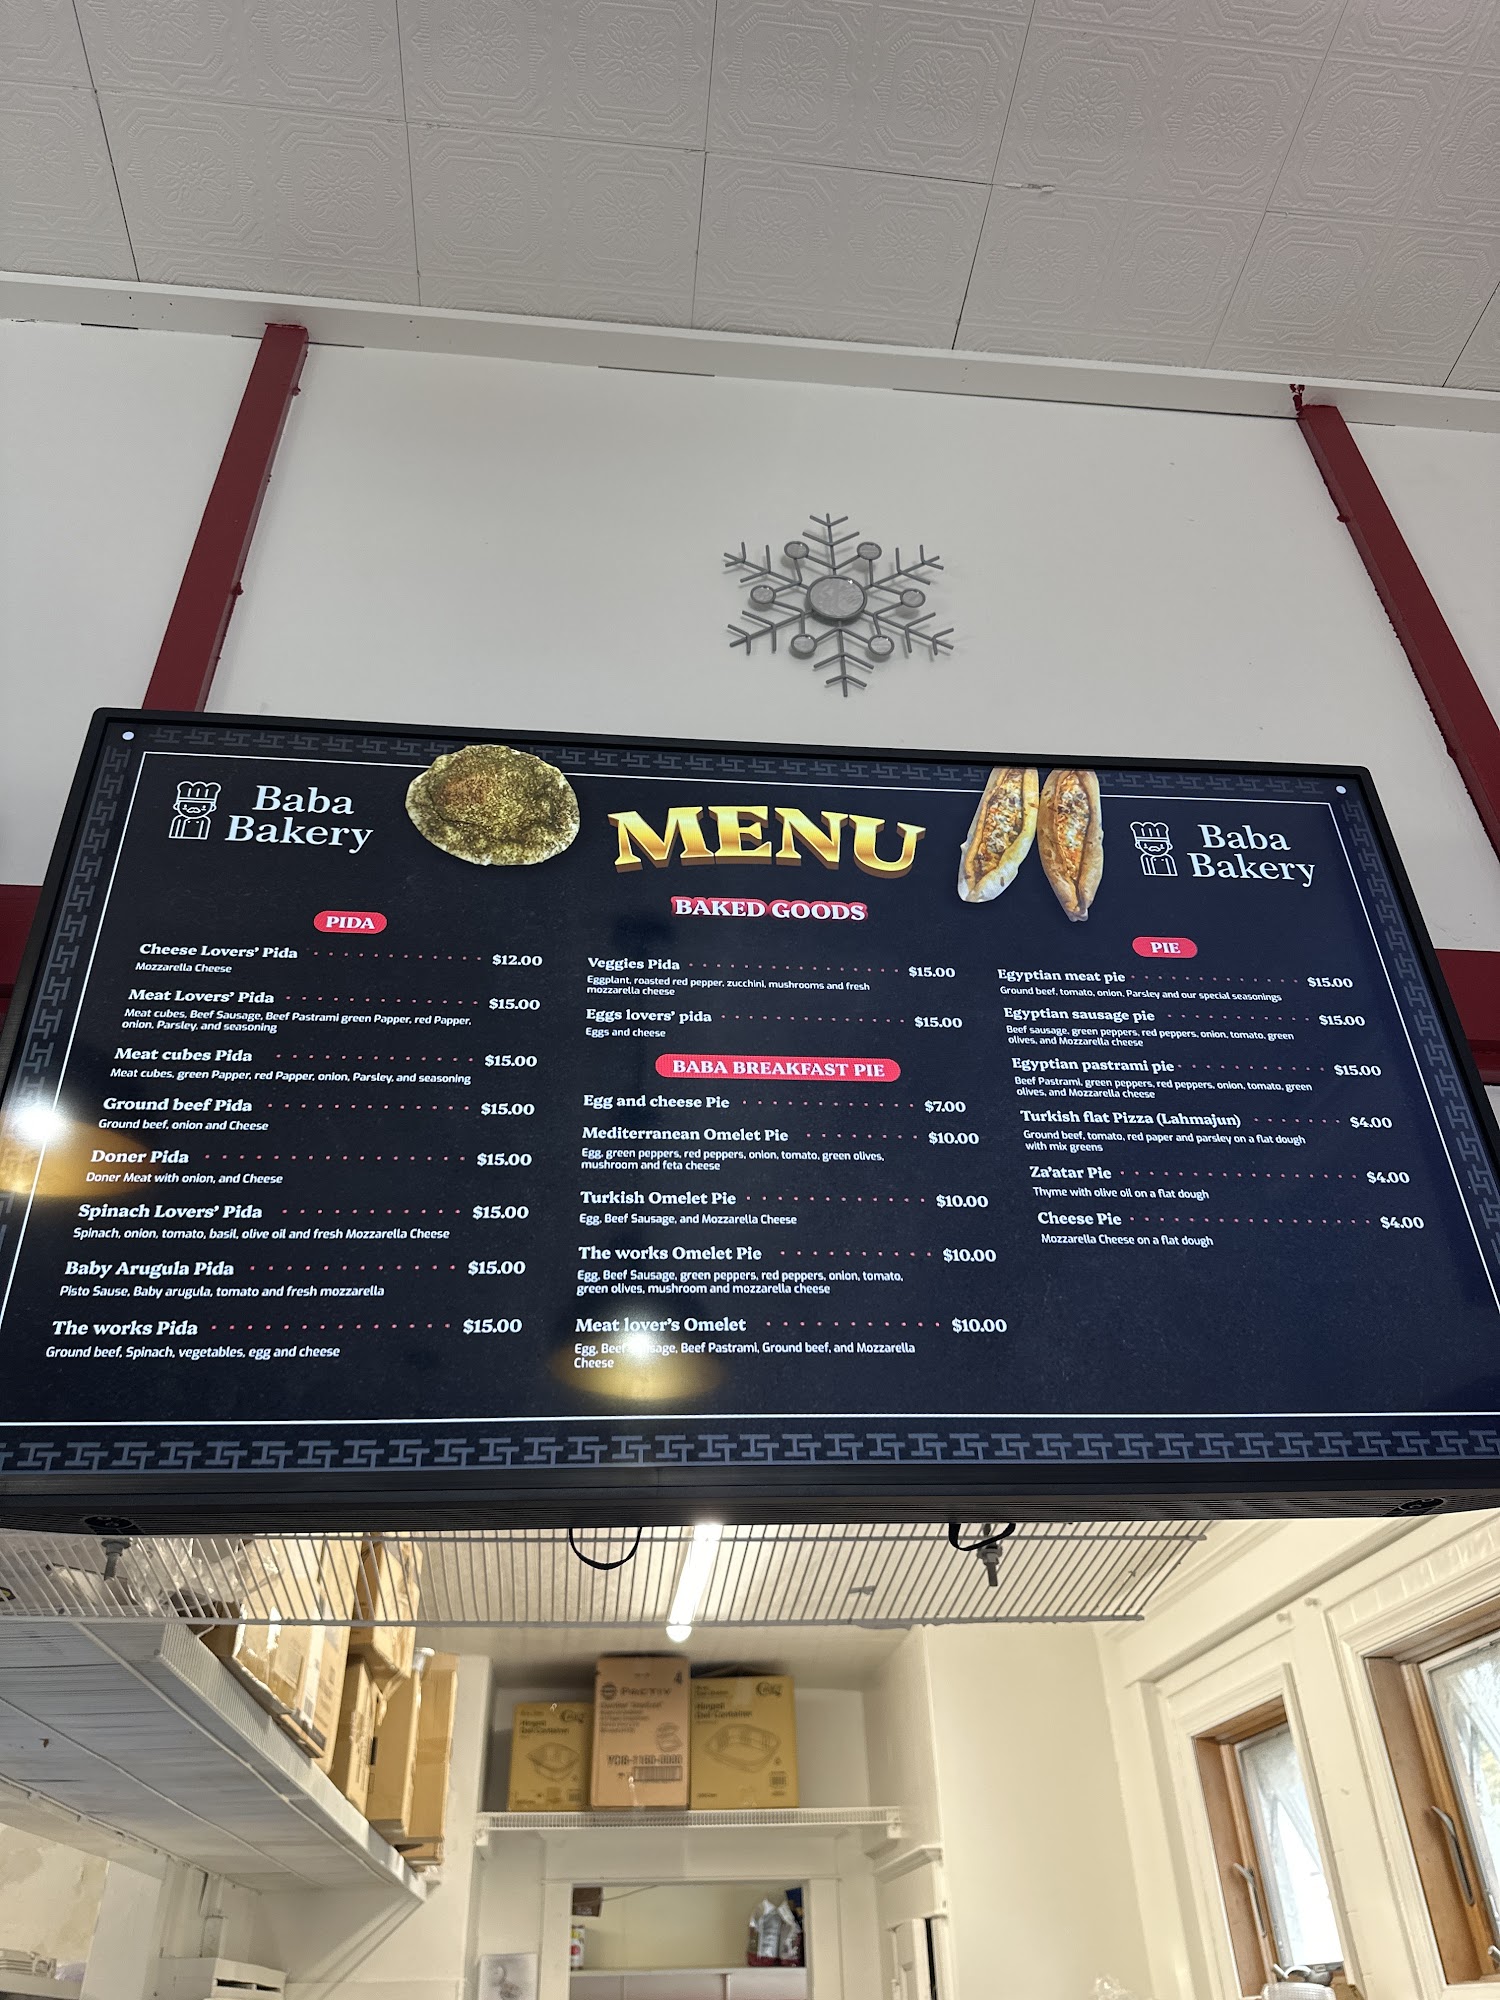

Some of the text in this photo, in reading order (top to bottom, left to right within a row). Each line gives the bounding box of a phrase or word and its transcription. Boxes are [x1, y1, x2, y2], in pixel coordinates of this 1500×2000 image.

[252, 784, 355, 816] Baba
[224, 815, 374, 855] Bakery
[1197, 824, 1292, 852] Baba
[607, 806, 928, 880] MENU
[1186, 852, 1315, 887] Bakery
[675, 898, 865, 920] BAKED GOODS
[325, 916, 375, 929] PIDA
[139, 943, 197, 955] Cheese
[261, 946, 298, 959] Pida
[1150, 941, 1181, 953] PIE
[135, 962, 232, 973] Mozzarella Cheese
[492, 954, 543, 966] $12.00
[587, 957, 680, 971] Veggies Pida
[908, 966, 955, 978] $15.00
[997, 968, 1125, 984] Egyptian meat pie
[1307, 976, 1353, 988] $15.00
[127, 988, 172, 1001] Meat
[237, 991, 274, 1003] Pida
[999, 985, 1034, 995] Ground
[1035, 986, 1058, 996] beef,
[1059, 988, 1095, 997] tomato,
[1096, 988, 1125, 997] onion,
[1125, 989, 1160, 999] Parsley
[1161, 990, 1180, 998] and
[1198, 991, 1231, 1001] special
[1231, 992, 1282, 1003] seasonings
[488, 997, 540, 1010] $15.00
[586, 1008, 622, 1023] Eggs
[679, 1010, 712, 1024] pida
[914, 1016, 963, 1028] $15.00
[1003, 1007, 1155, 1023] Egyptian sausage pie
[1318, 1014, 1365, 1026] $15.00
[585, 1027, 666, 1038] Eggs and cheese
[113, 1047, 252, 1062] Meat cubes Pida
[484, 1054, 537, 1067] $15.00
[673, 1060, 885, 1077] BABA BREAKFAST PIE
[1011, 1057, 1174, 1074] Egyptian pastrami pie
[1333, 1064, 1381, 1076] $15.00
[103, 1097, 252, 1112] Ground beef Pida
[480, 1102, 535, 1116] $15.00
[583, 1094, 730, 1109] Egg and cheese Pie
[924, 1099, 966, 1113] $7.00
[98, 1118, 269, 1130] Ground beef, onion and Cheese
[1019, 1109, 1241, 1128] Turkish flat Pizza (Lahmajun)
[1349, 1116, 1392, 1128] $4.00
[581, 1126, 788, 1141] Mediterranean Omelet Pie
[928, 1131, 979, 1145] $10.00
[90, 1149, 189, 1163] Doner Pida
[477, 1152, 532, 1166] $15.00
[86, 1172, 283, 1184] Doner Meat with onion, and Cheese
[1086, 1166, 1111, 1179] Pie
[1366, 1170, 1410, 1184] $4.00
[580, 1190, 736, 1205] Turkish Omelet Pie
[935, 1193, 989, 1208] $10.00
[1032, 1186, 1210, 1201] Thyme with olive oil on a flat dough
[77, 1203, 150, 1221] Spinach
[222, 1204, 262, 1218] Pida
[472, 1205, 529, 1220] $15.00
[579, 1213, 797, 1226] Egg, Beef Sausage, and Mozzarella Cheese
[1037, 1211, 1122, 1225] Cheese Pie
[1379, 1215, 1424, 1229] $4.00
[1041, 1233, 1214, 1248] Mozzarella Cheese on a flat dough
[578, 1245, 762, 1260] The works Omelet Pie
[942, 1247, 997, 1263] $10.00
[64, 1260, 234, 1279] Baby Arugula Pida
[467, 1260, 526, 1276] $15.00
[59, 1285, 385, 1299] Pisto Sause, Baby arugula, tomato and fresh mozzarella
[52, 1319, 198, 1335] The works Pida
[462, 1318, 522, 1335] $15.00
[575, 1318, 620, 1333] Meat
[684, 1317, 748, 1333] Omelet
[951, 1317, 1007, 1333] $10.00
